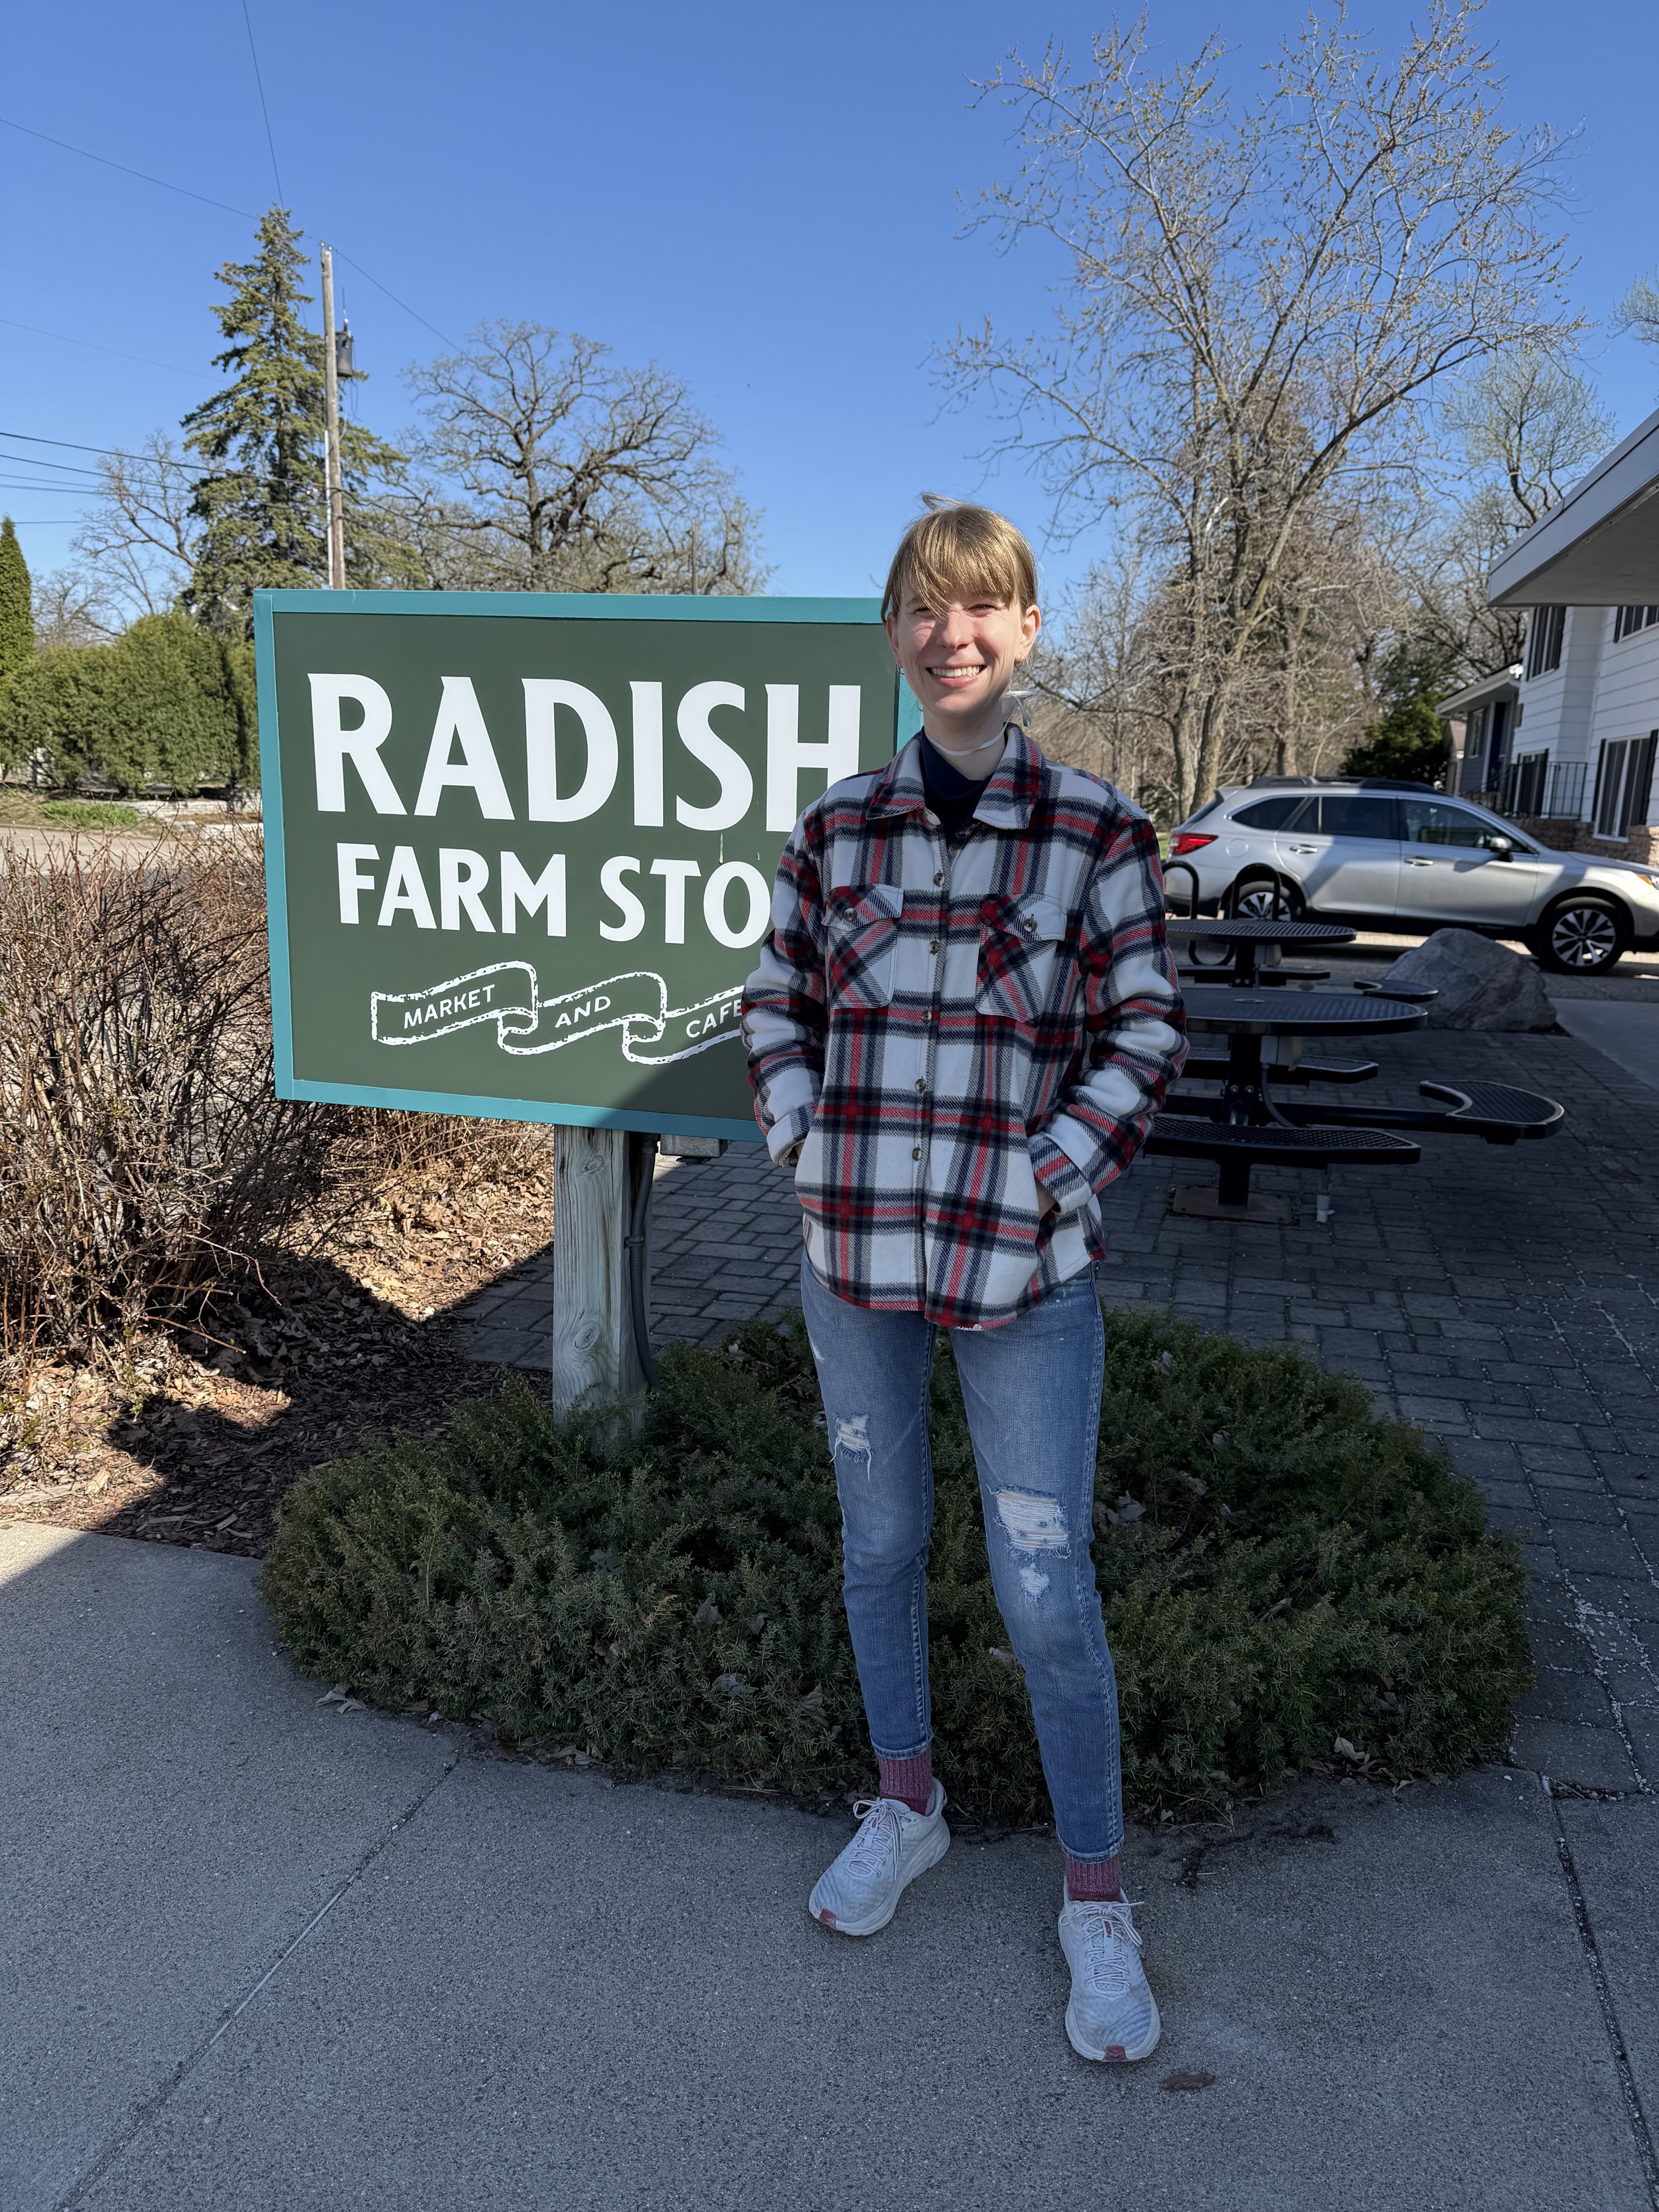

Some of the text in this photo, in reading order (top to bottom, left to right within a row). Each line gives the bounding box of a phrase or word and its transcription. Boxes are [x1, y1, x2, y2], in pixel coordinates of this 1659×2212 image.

[307, 673, 861, 833] RADISH
[336, 842, 771, 949] FARM STO
[403, 984, 496, 1029] MARKET
[554, 995, 611, 1028] AND
